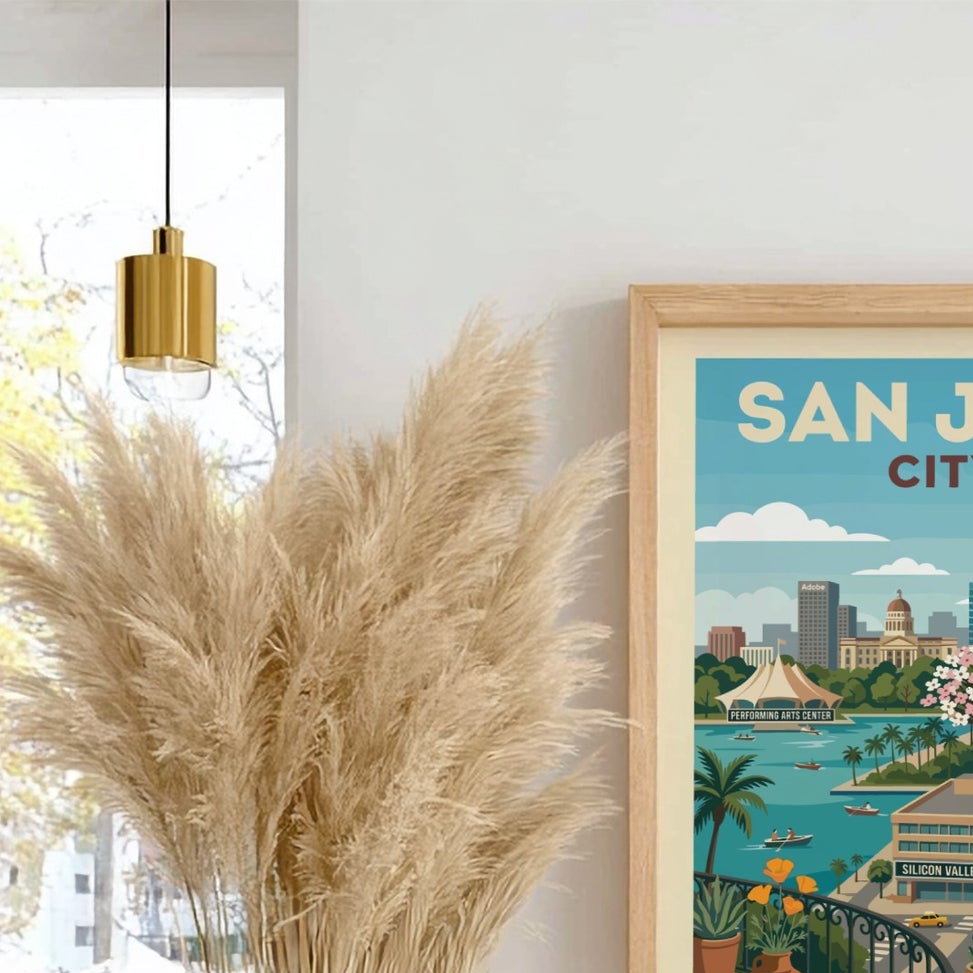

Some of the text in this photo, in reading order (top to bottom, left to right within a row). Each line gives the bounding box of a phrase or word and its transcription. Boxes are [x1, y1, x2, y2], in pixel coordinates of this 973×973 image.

[738, 381, 907, 443] SAN
[801, 583, 826, 591] Adobe
[730, 711, 832, 720] PERFORMING ARTS CENTER
[902, 863, 942, 876] SILICON
